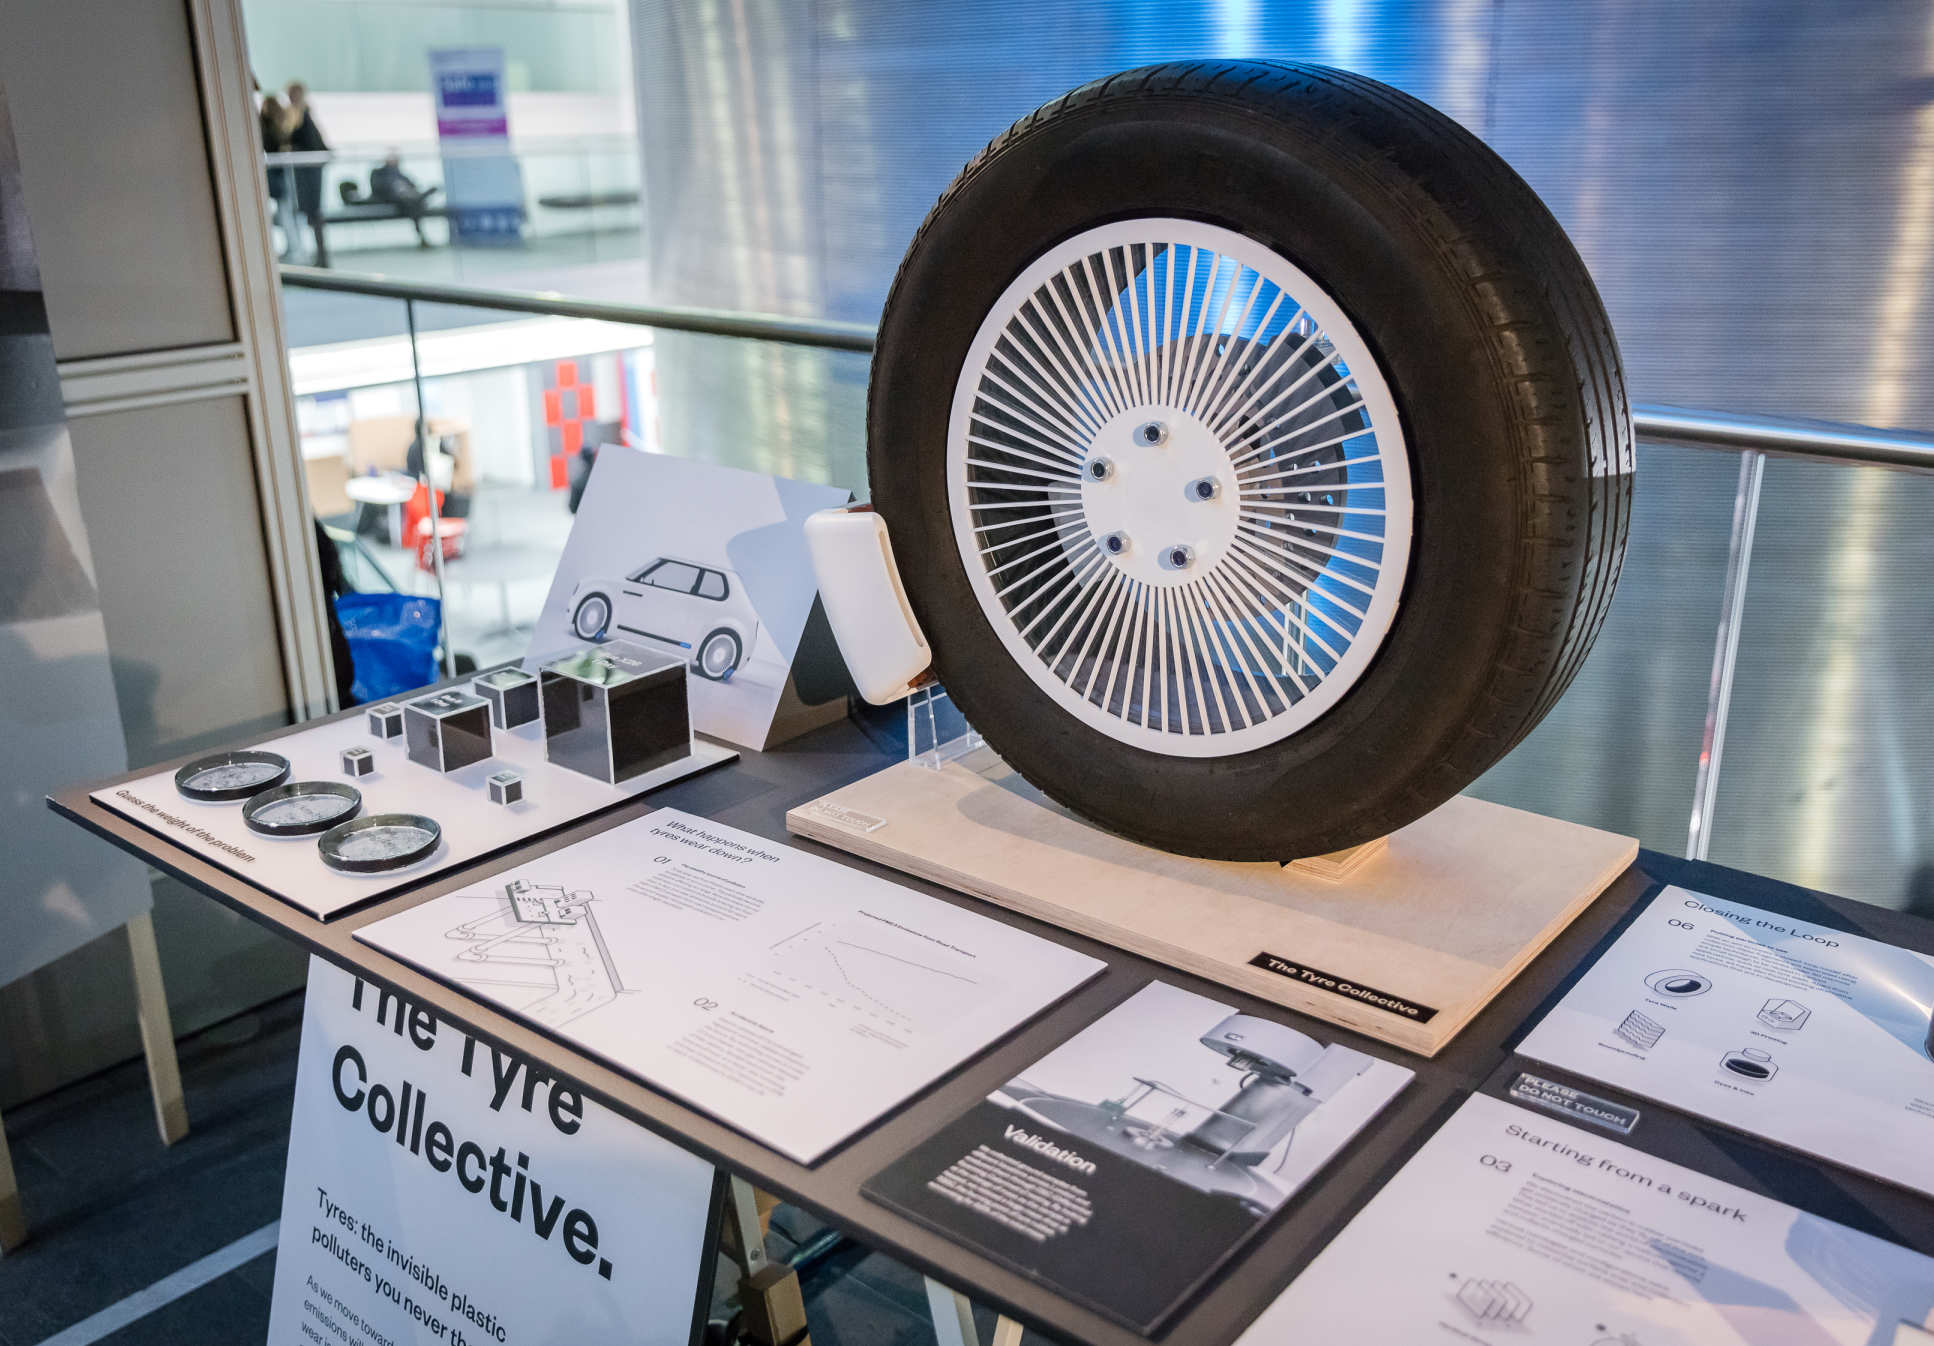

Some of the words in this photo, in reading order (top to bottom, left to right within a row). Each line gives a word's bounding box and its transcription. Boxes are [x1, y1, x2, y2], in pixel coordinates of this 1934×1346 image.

[116, 790, 144, 806] Guess
[142, 803, 159, 814] the
[156, 810, 190, 830] weight
[198, 830, 215, 842] the
[209, 839, 256, 863] problem
[650, 828, 680, 841] tyres
[680, 838, 710, 850] wear
[708, 848, 752, 864] down?
[666, 821, 698, 836] What
[696, 831, 746, 851] happens
[748, 848, 780, 863] when
[654, 856, 672, 864] 01
[1668, 918, 1696, 931] 06
[1684, 900, 1751, 925] Closing
[1756, 920, 1786, 933] the
[1790, 928, 1840, 948] Loop
[694, 998, 718, 1010] 02
[1268, 958, 1297, 974] The
[1301, 970, 1336, 988] Tyre
[1338, 983, 1419, 1016] Collective
[1519, 1084, 1540, 1096] DO
[1541, 1091, 1573, 1106] NOT
[1576, 1102, 1627, 1125] TOUCH
[1524, 1077, 1578, 1100] PLEASE
[332, 1044, 612, 1280] Collective.
[1004, 1124, 1097, 1174] Validation
[1479, 1154, 1513, 1174] 03
[1505, 1124, 1594, 1167] Starting
[1598, 1158, 1653, 1187] from
[1657, 1182, 1672, 1195] a
[1678, 1189, 1748, 1222] spark
[312, 1226, 372, 1282] polluters
[375, 1274, 400, 1304] you
[404, 1296, 448, 1338] never
[317, 1187, 358, 1234] Tyres:
[361, 1223, 384, 1253] the
[387, 1240, 448, 1300] invisible
[450, 1293, 506, 1343] plastic
[304, 1300, 348, 1342] emissions
[306, 1275, 319, 1293] As
[320, 1288, 334, 1304] we
[334, 1300, 360, 1326] move
[302, 1322, 323, 1345] wear
